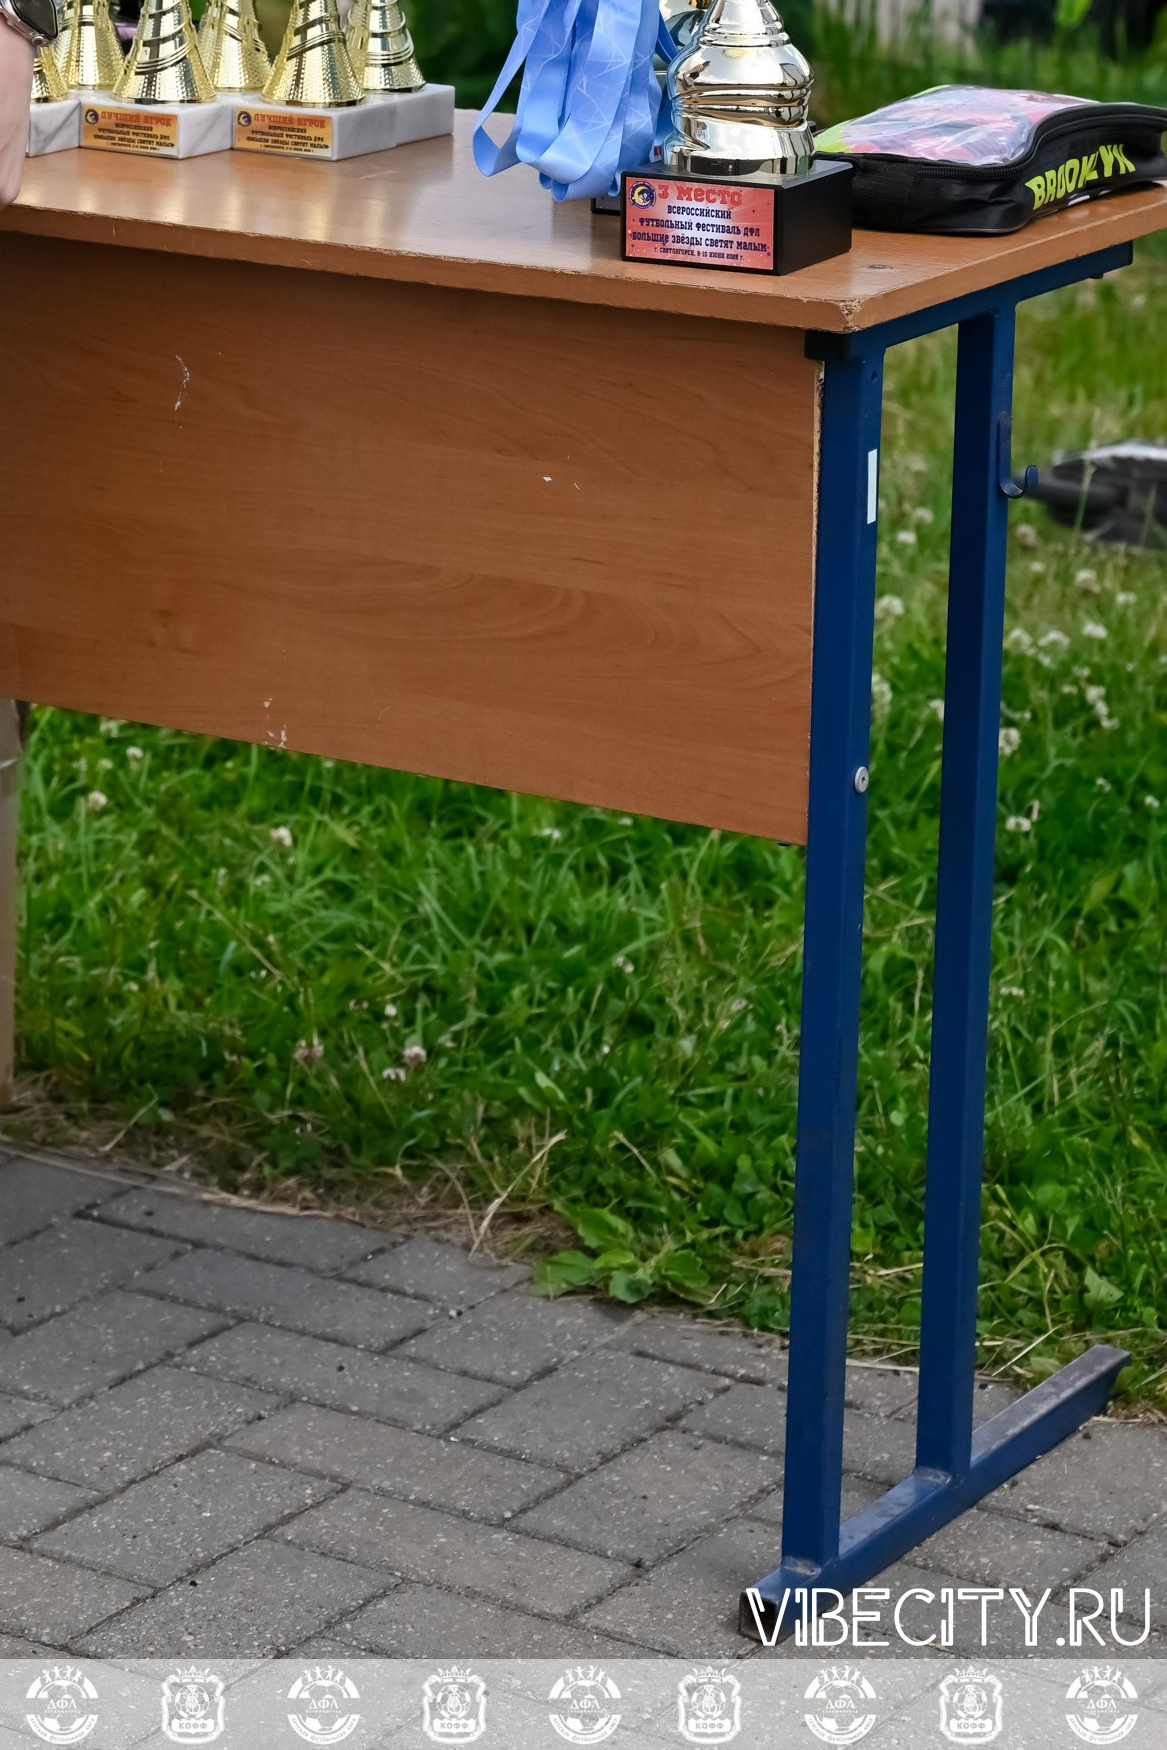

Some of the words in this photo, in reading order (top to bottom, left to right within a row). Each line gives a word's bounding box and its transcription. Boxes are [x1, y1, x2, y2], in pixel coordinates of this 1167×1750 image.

[101, 111, 140, 122] ЛУЧШИЙ
[144, 116, 172, 127] ИГРОК
[254, 114, 294, 125] ЛУЧШИЙ
[297, 118, 326, 128] ИГРОК
[658, 184, 669, 199] 3
[638, 217, 693, 230] ФУТБОЛЬНЫЙ
[743, 226, 760, 237] ДФЛ
[705, 238, 734, 249] СВЕТЯТ
